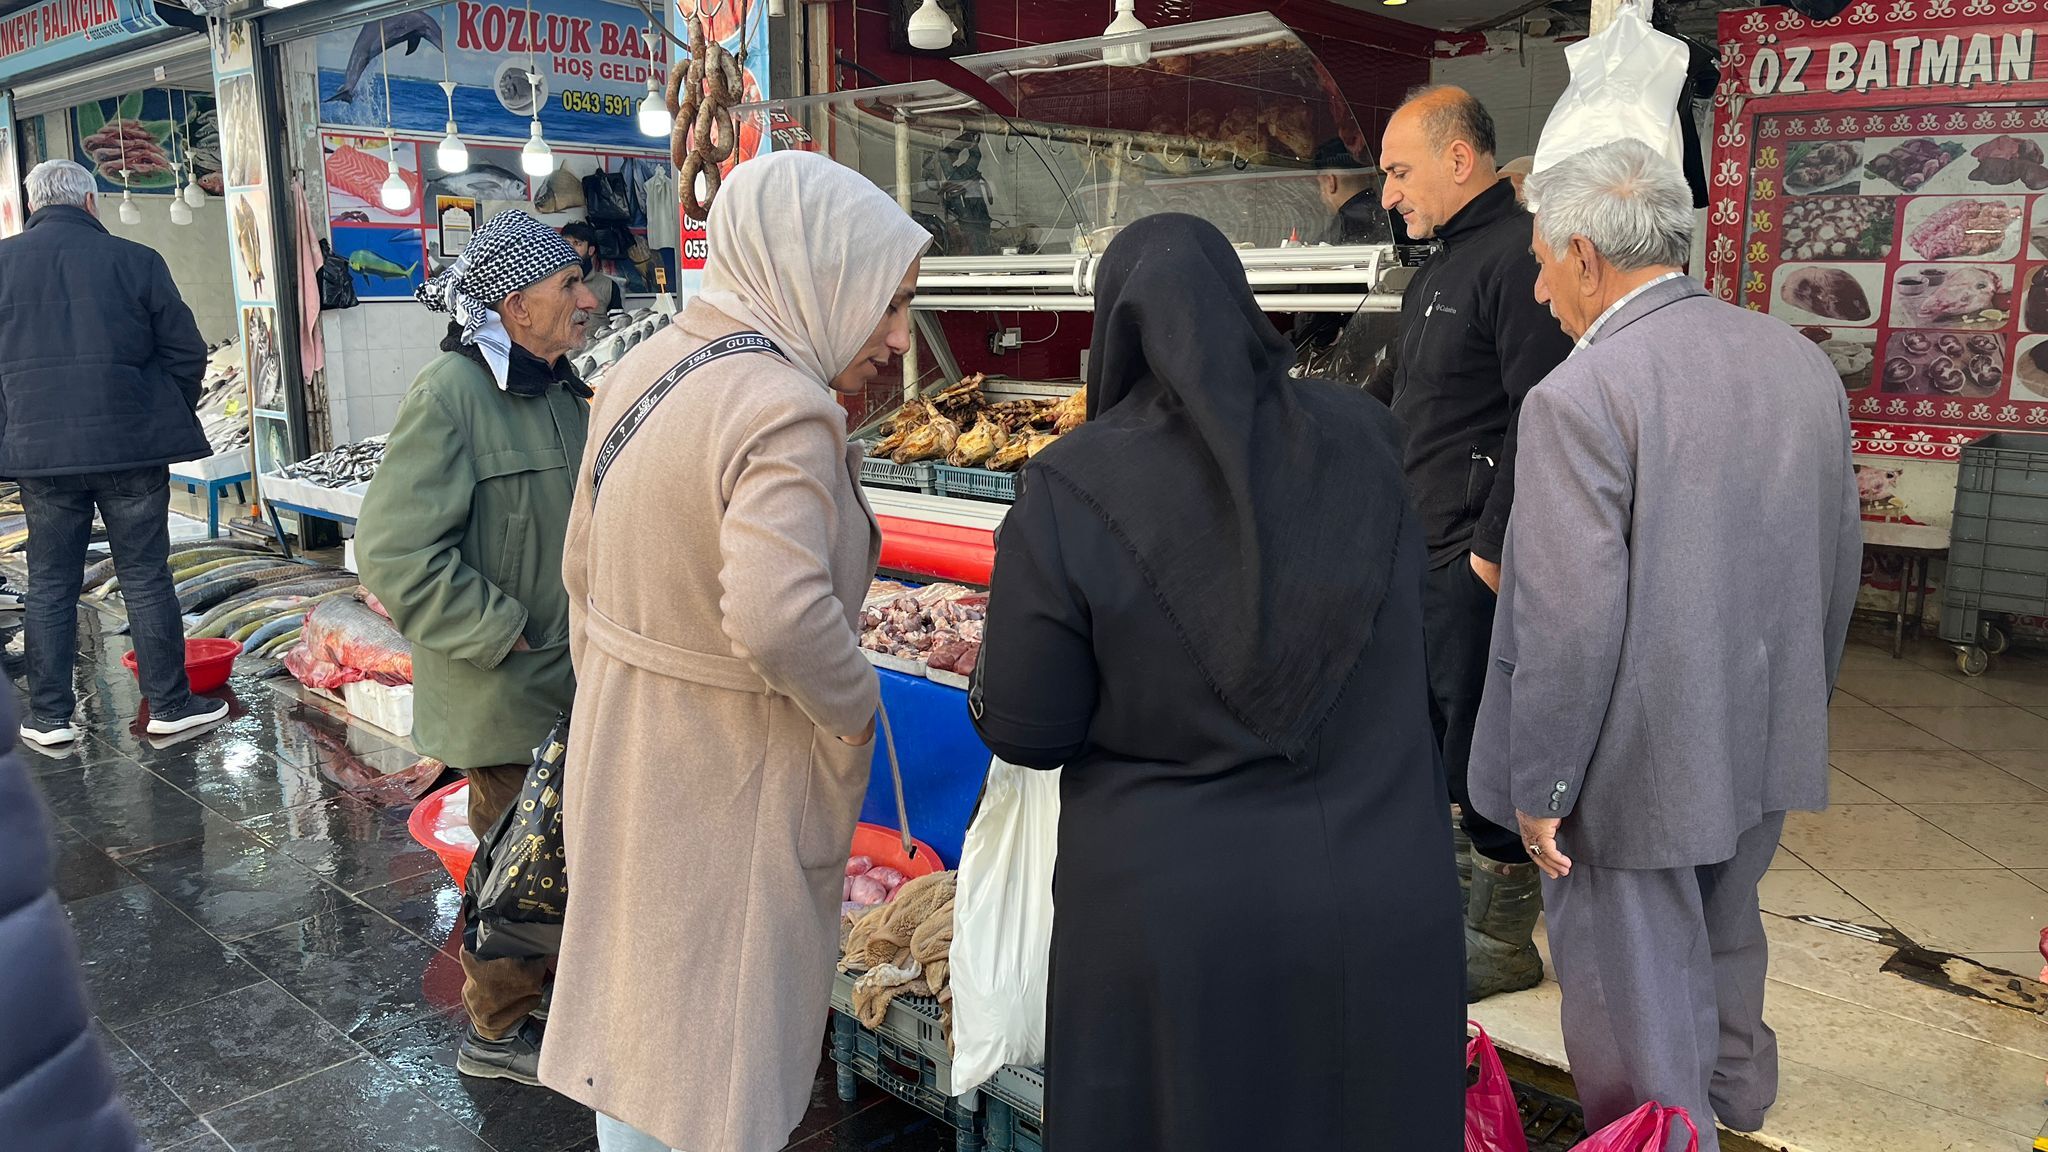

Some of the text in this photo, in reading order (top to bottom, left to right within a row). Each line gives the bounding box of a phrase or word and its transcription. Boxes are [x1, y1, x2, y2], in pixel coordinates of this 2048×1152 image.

[0, 10, 38, 58] NKEYF
[457, 2, 591, 53] KOZLUK
[553, 56, 593, 81] HOŞ
[1749, 28, 2035, 95] ÖZ BATMAN
[563, 90, 601, 113] 0543
[605, 94, 631, 116] 591
[684, 239, 708, 259] 053
[726, 337, 771, 349] GUESS
[687, 349, 713, 367] 1981
